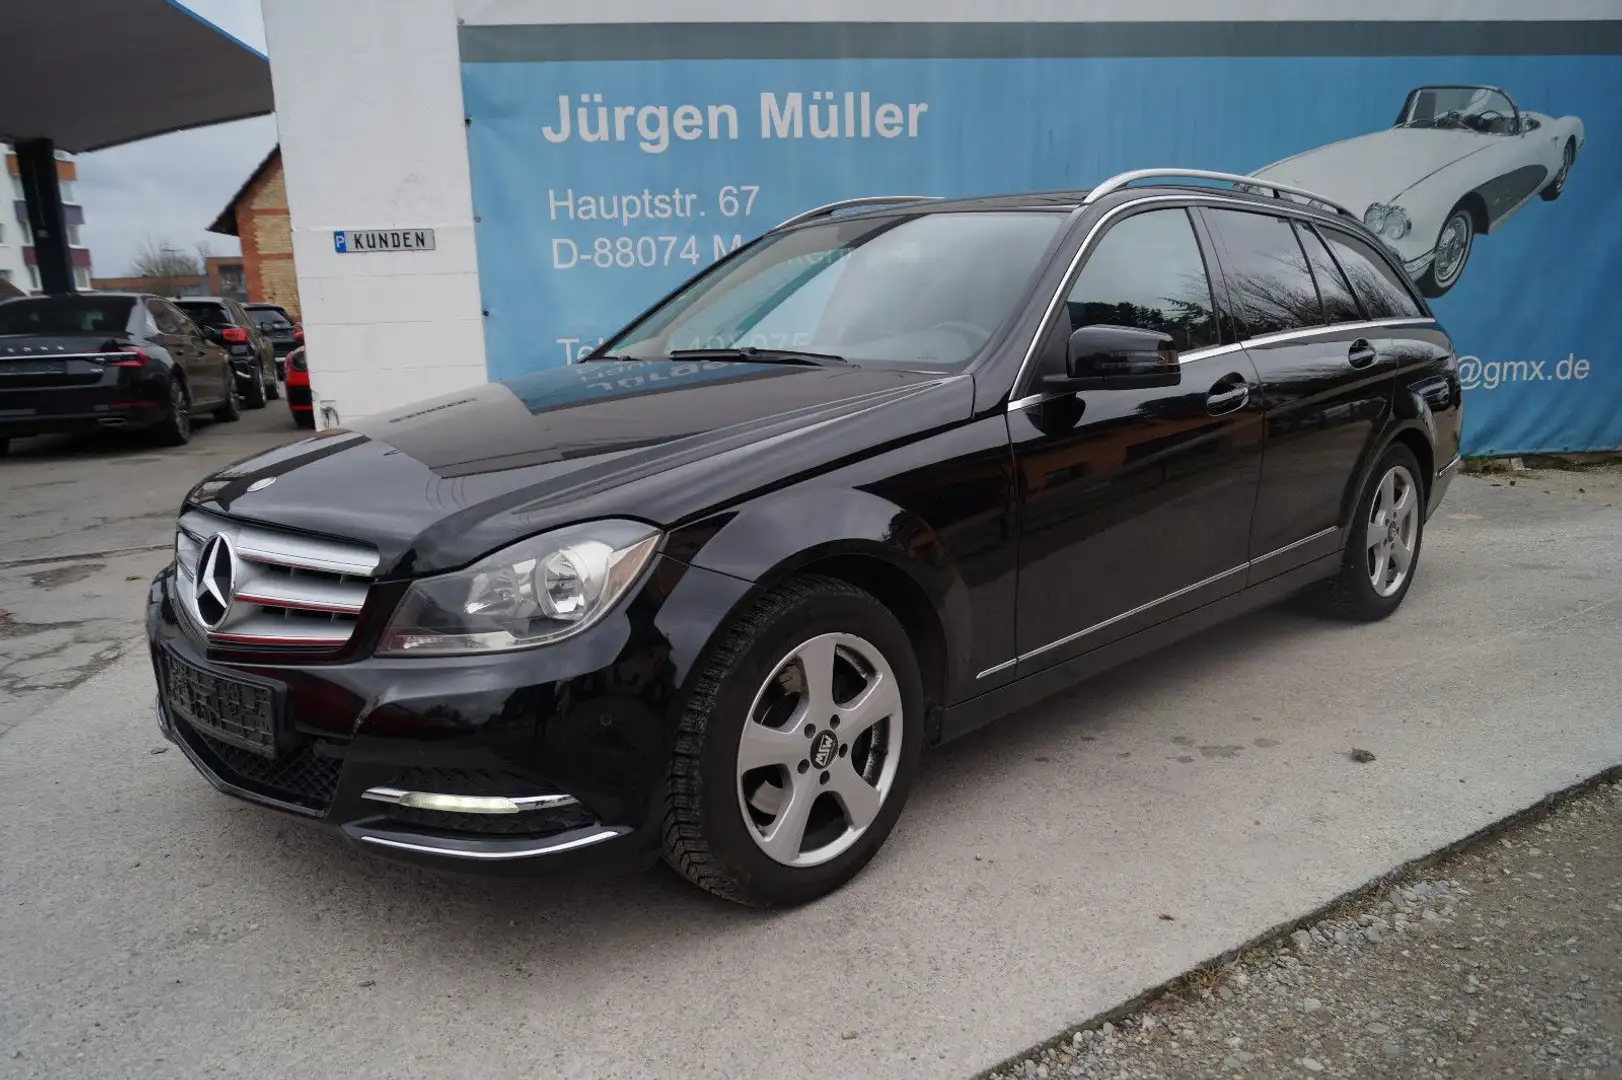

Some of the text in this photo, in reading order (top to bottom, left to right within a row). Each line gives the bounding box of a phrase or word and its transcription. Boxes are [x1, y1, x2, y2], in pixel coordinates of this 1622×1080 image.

[541, 91, 929, 154] Jürgen Müller
[548, 185, 761, 226] Hauptstr. 67
[353, 231, 426, 250] KUNDEN
[551, 235, 701, 270] D-88074
[556, 337, 604, 366] Te
